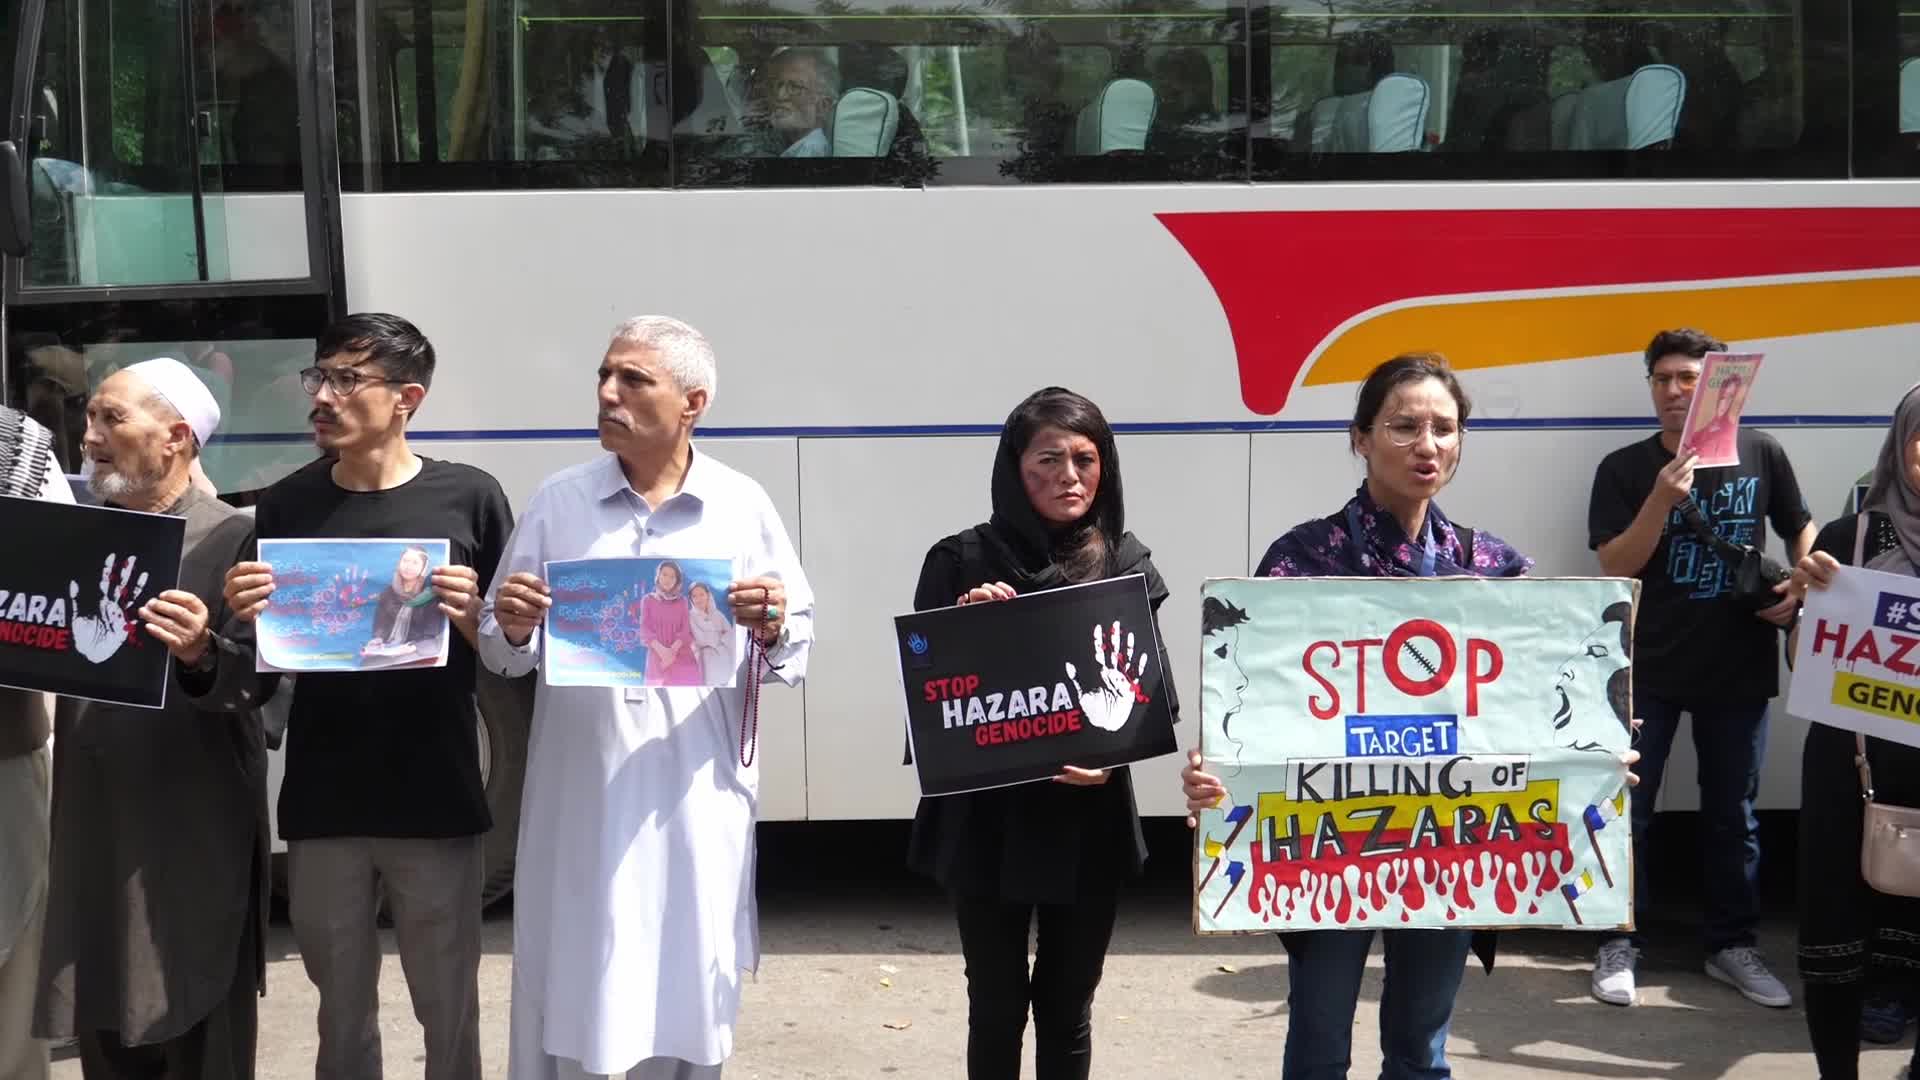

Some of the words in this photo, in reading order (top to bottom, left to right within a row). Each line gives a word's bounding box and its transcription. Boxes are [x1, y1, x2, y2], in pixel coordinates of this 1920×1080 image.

[1302, 618, 1504, 720] STOP
[1812, 618, 1920, 677] HAZ
[924, 675, 980, 702] STOP
[942, 682, 1074, 729] HAZARA
[1848, 682, 1920, 717] GEN
[975, 710, 1082, 746] GENOCIDE
[1350, 721, 1453, 757] TARGET
[1297, 756, 1474, 803] KILLING
[1492, 761, 1526, 787] OF
[1261, 797, 1556, 864] HAZARAS
